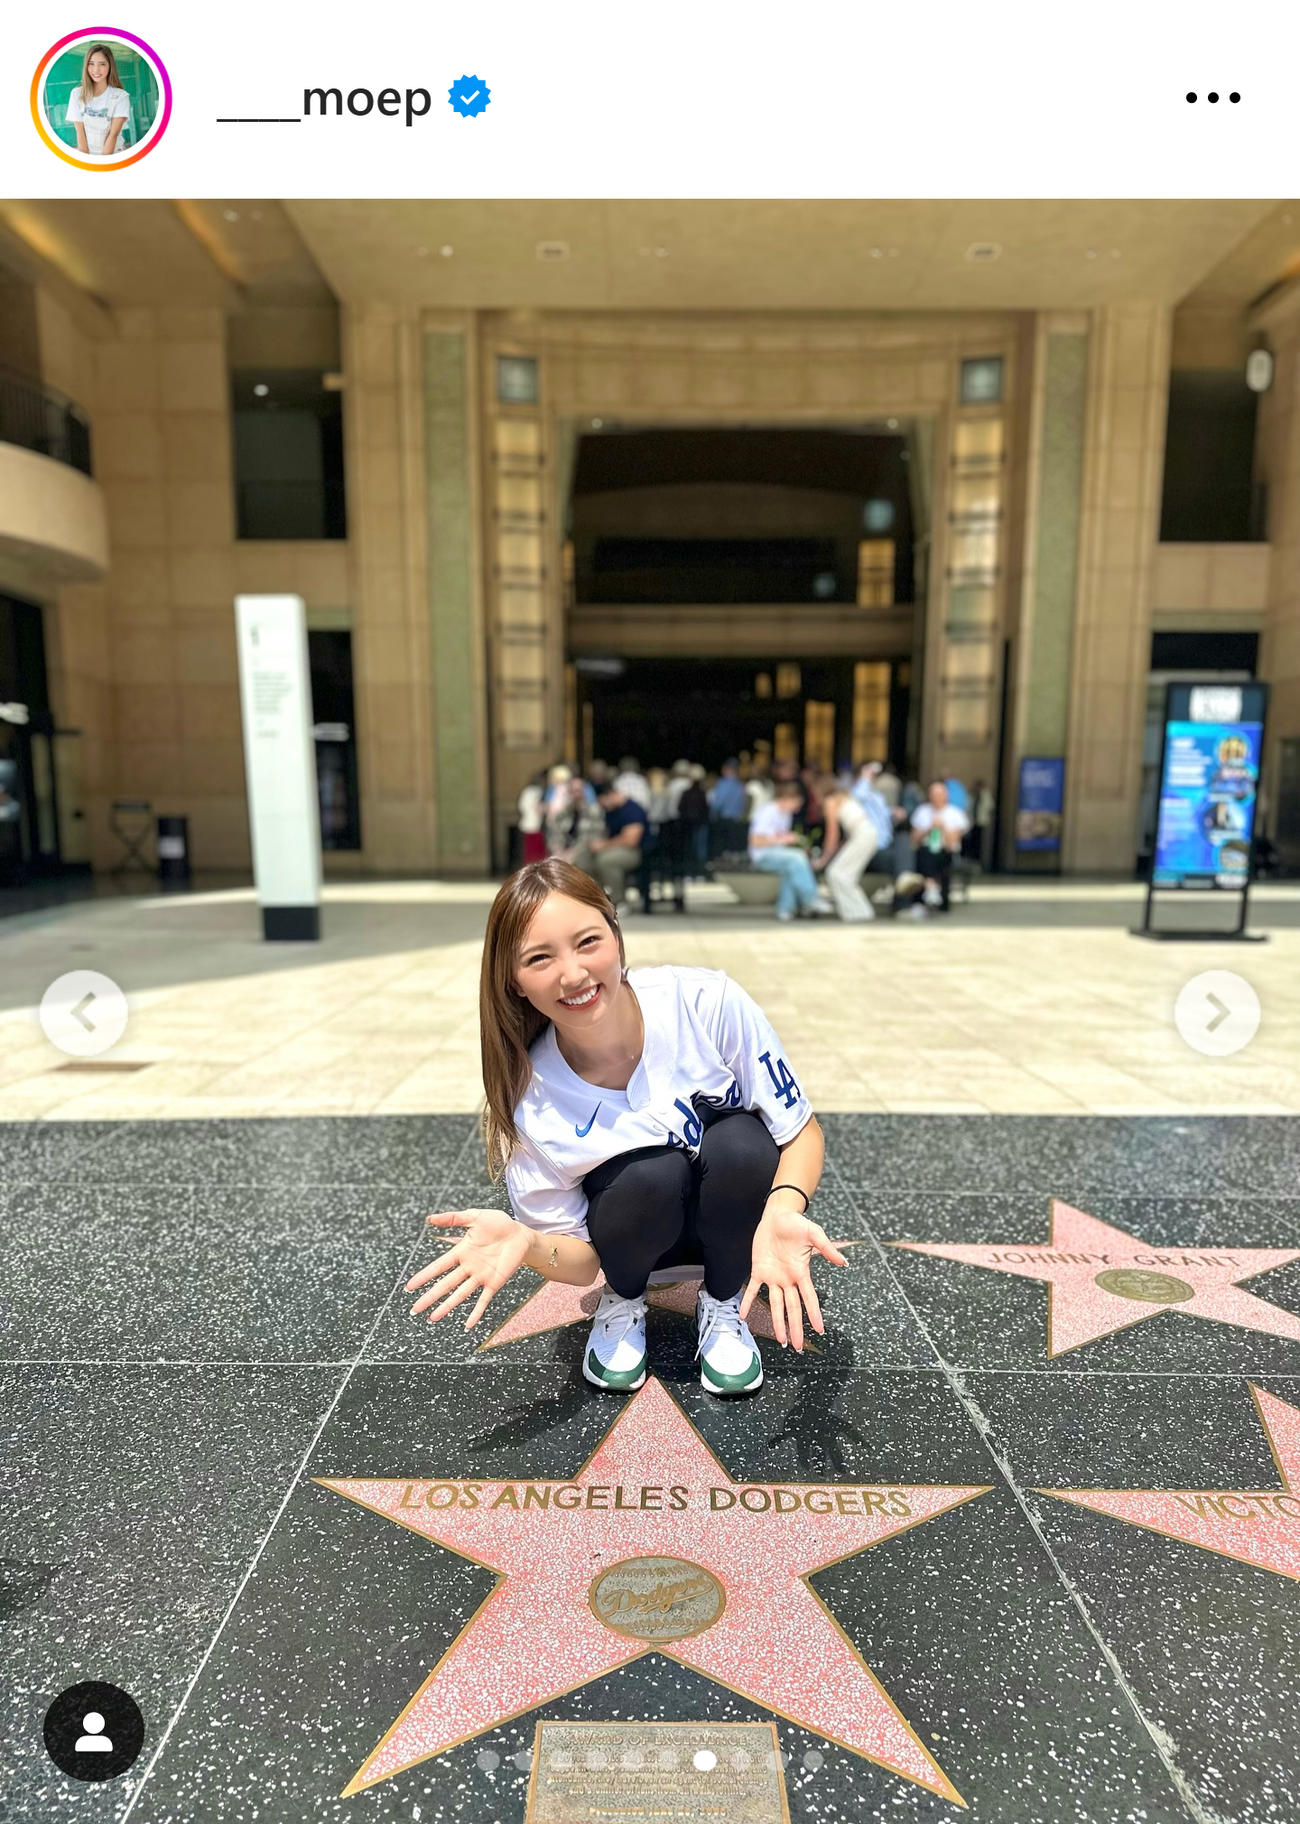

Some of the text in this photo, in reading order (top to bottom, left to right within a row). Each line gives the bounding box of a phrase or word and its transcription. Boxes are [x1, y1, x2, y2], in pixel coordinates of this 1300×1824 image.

[758, 1051, 801, 1110] LA
[988, 1251, 1241, 1267] JOHNNY GRANT
[400, 1484, 913, 1517] LOS ANGELES DODGERS
